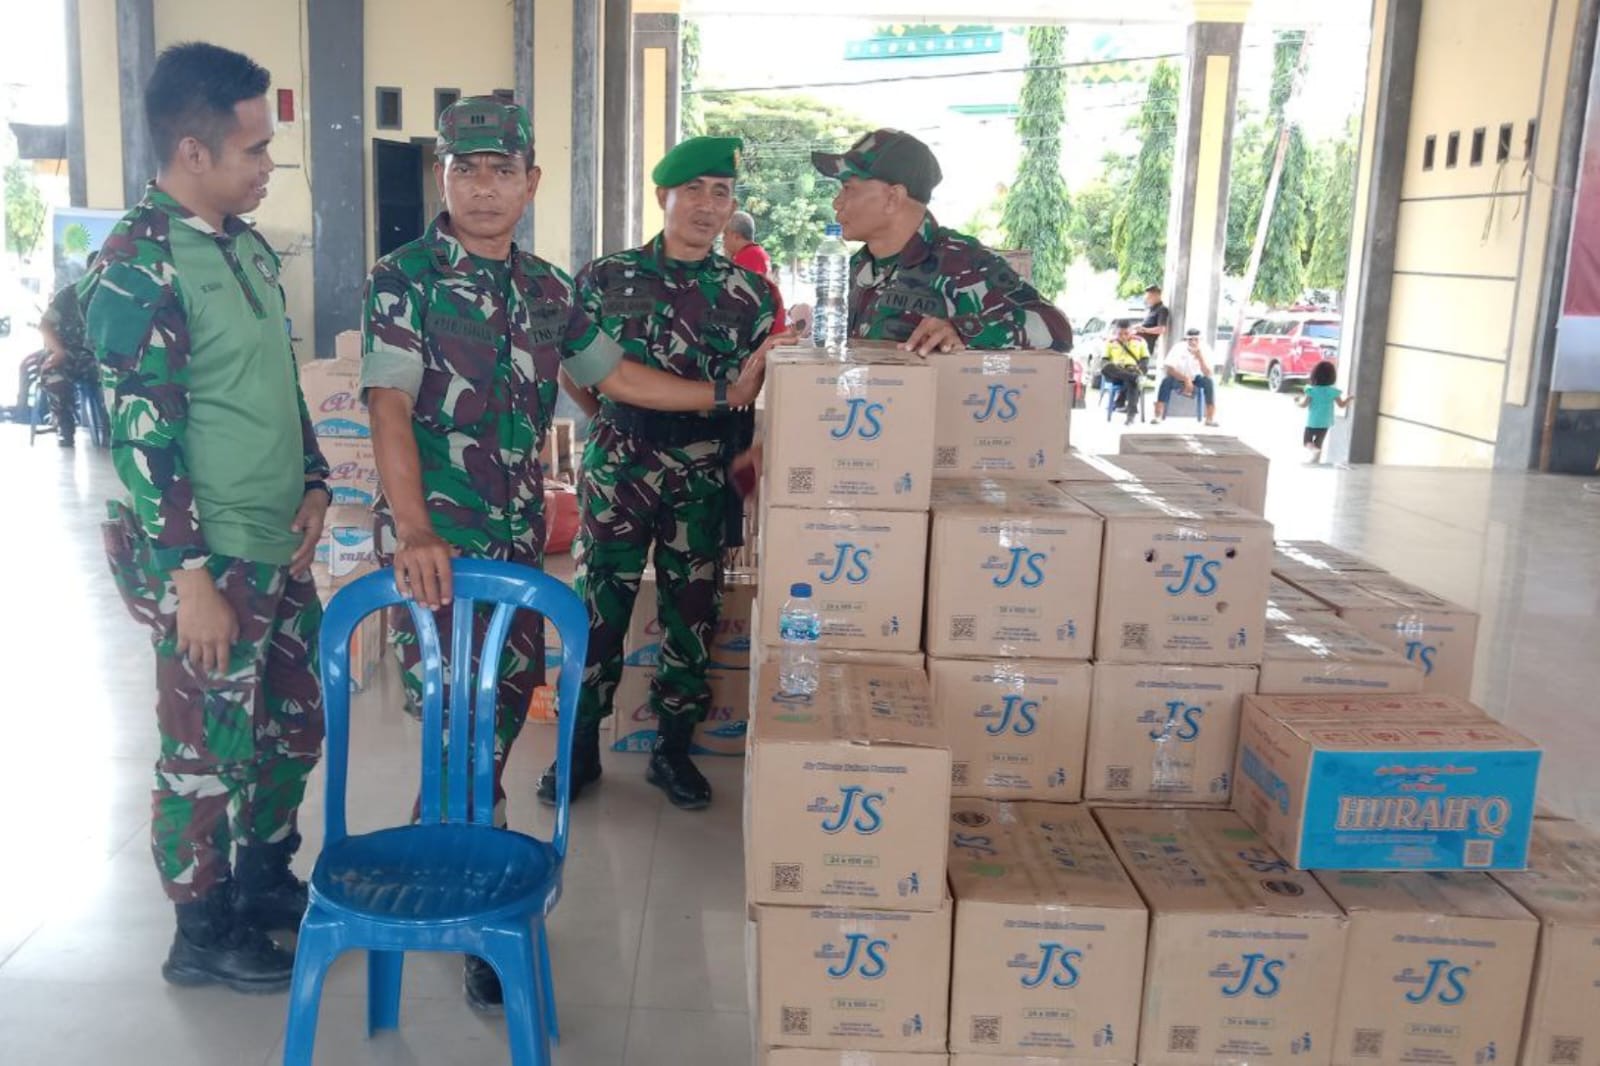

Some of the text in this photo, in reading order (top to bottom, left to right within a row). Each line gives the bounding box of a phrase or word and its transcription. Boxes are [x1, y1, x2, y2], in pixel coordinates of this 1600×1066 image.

[831, 397, 886, 440] JS
[973, 384, 1021, 422] JS
[820, 542, 874, 584] JS
[993, 546, 1048, 588] JS
[1166, 553, 1221, 597] JS
[986, 694, 1039, 736] JS
[1149, 700, 1203, 743] JS
[821, 784, 886, 835] JS
[1335, 795, 1511, 836] HIJRAH'Q
[827, 932, 890, 980] JS
[1021, 942, 1083, 989] JS
[1222, 952, 1286, 998] JS
[1404, 958, 1472, 1007] JS
